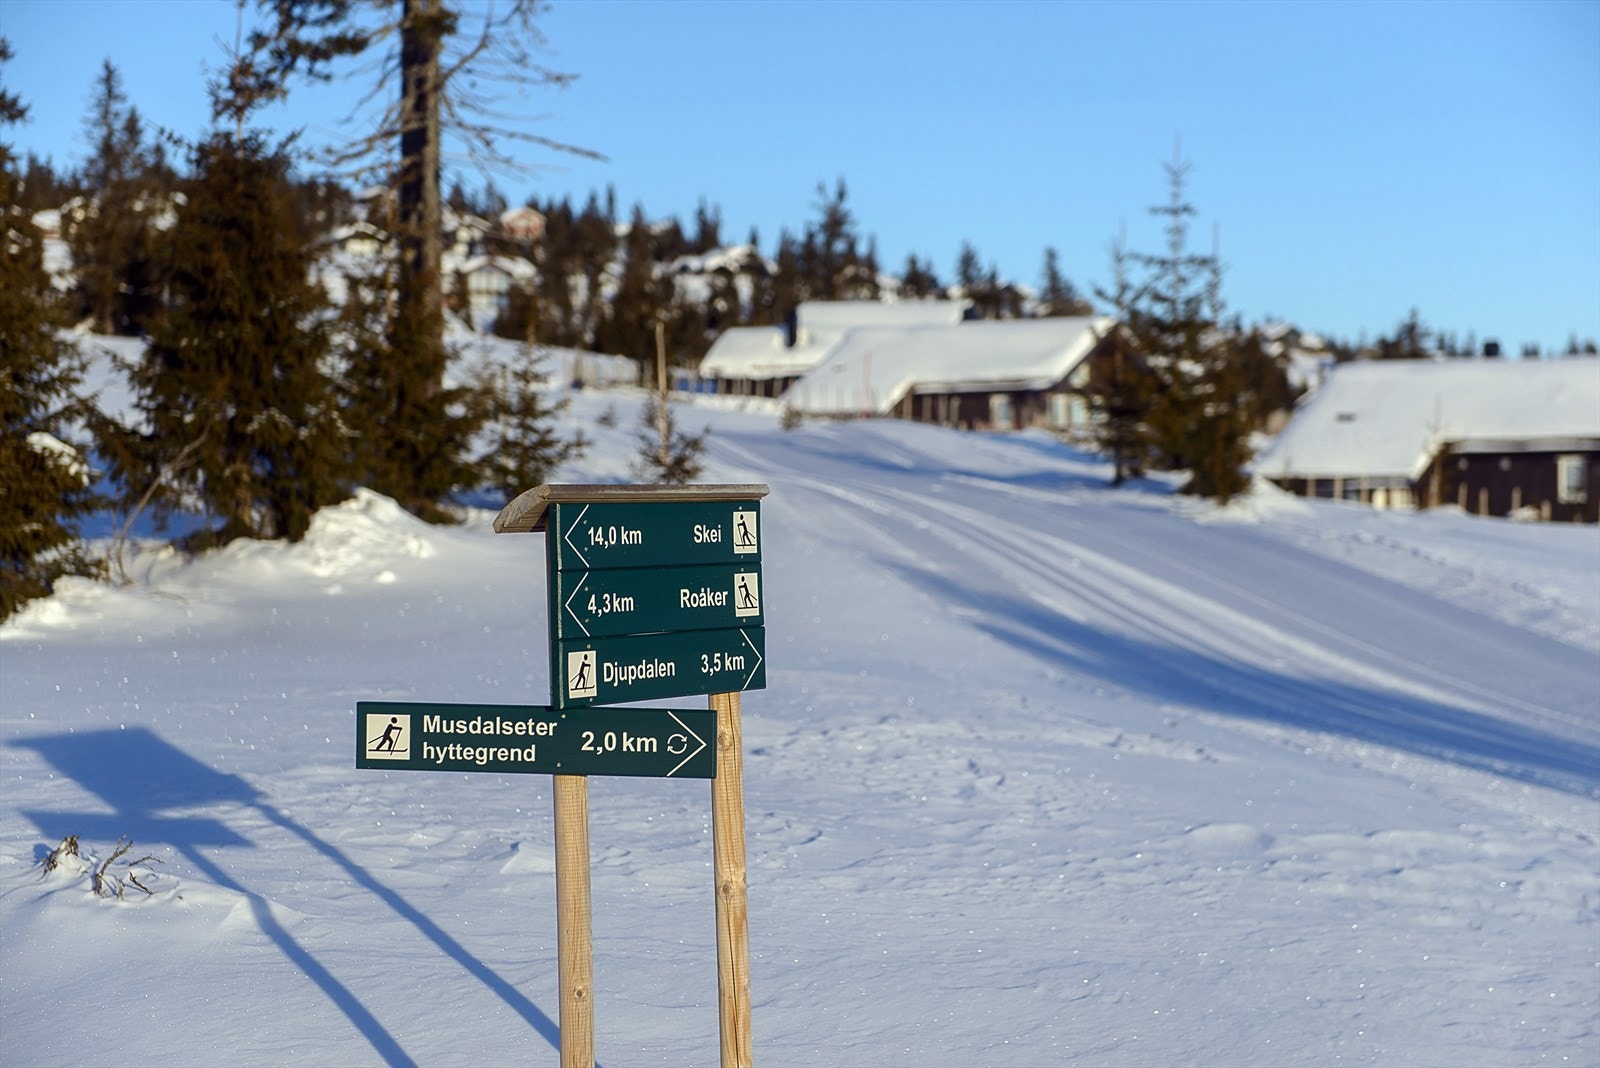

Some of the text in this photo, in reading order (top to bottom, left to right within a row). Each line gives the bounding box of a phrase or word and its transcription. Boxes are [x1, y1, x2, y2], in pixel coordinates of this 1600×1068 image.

[588, 526, 641, 548] 14,0 km
[694, 525, 721, 543] Skei
[681, 588, 728, 608] Roåker
[604, 659, 675, 686] Djupdalen
[701, 653, 744, 676] 3,5 km
[424, 715, 557, 736] Musdalseter
[423, 742, 535, 765] hyttegrend
[581, 731, 657, 755] 2,0 km
